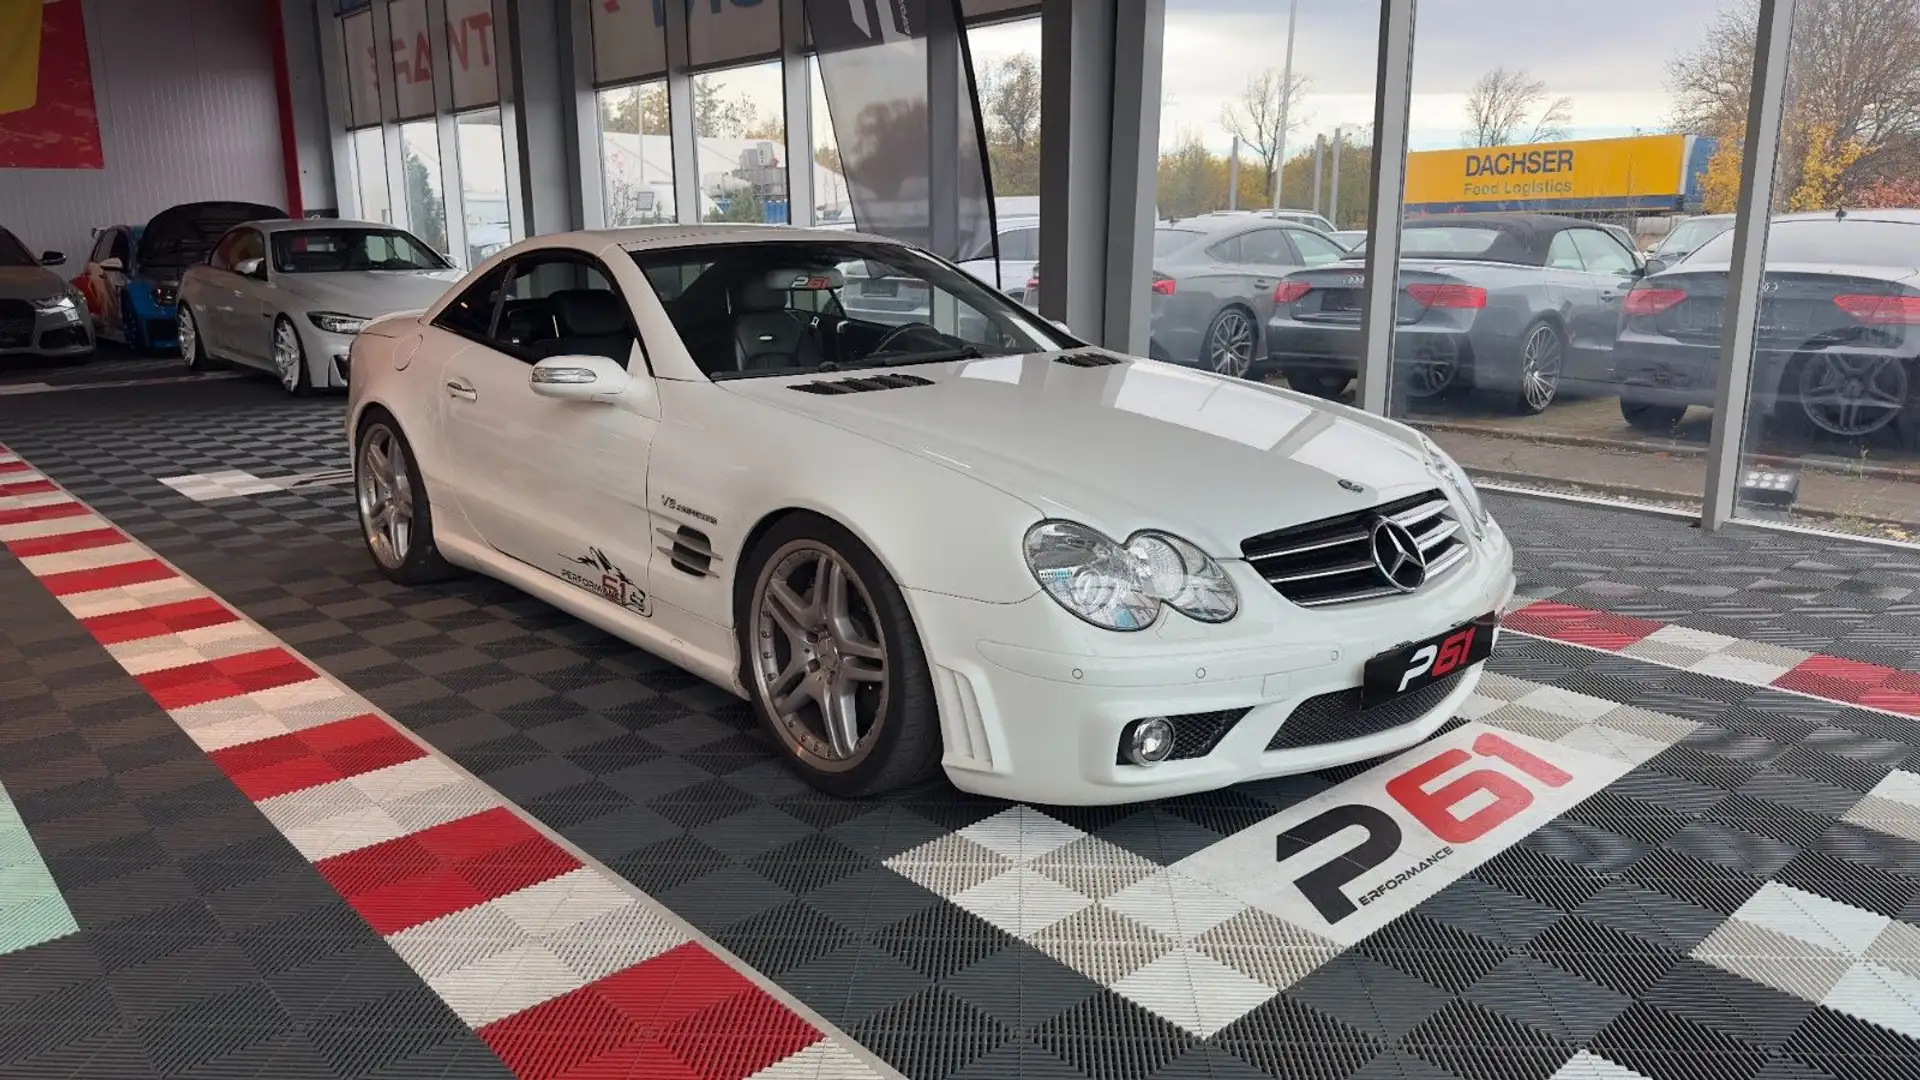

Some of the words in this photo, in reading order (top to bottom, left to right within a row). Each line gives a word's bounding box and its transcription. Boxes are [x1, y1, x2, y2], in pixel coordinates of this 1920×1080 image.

[1465, 149, 1574, 177] DACHSER
[1463, 181, 1499, 196] Food
[1504, 179, 1572, 196] Logistics
[1397, 626, 1476, 692] P61
[1276, 731, 1574, 925] P61
